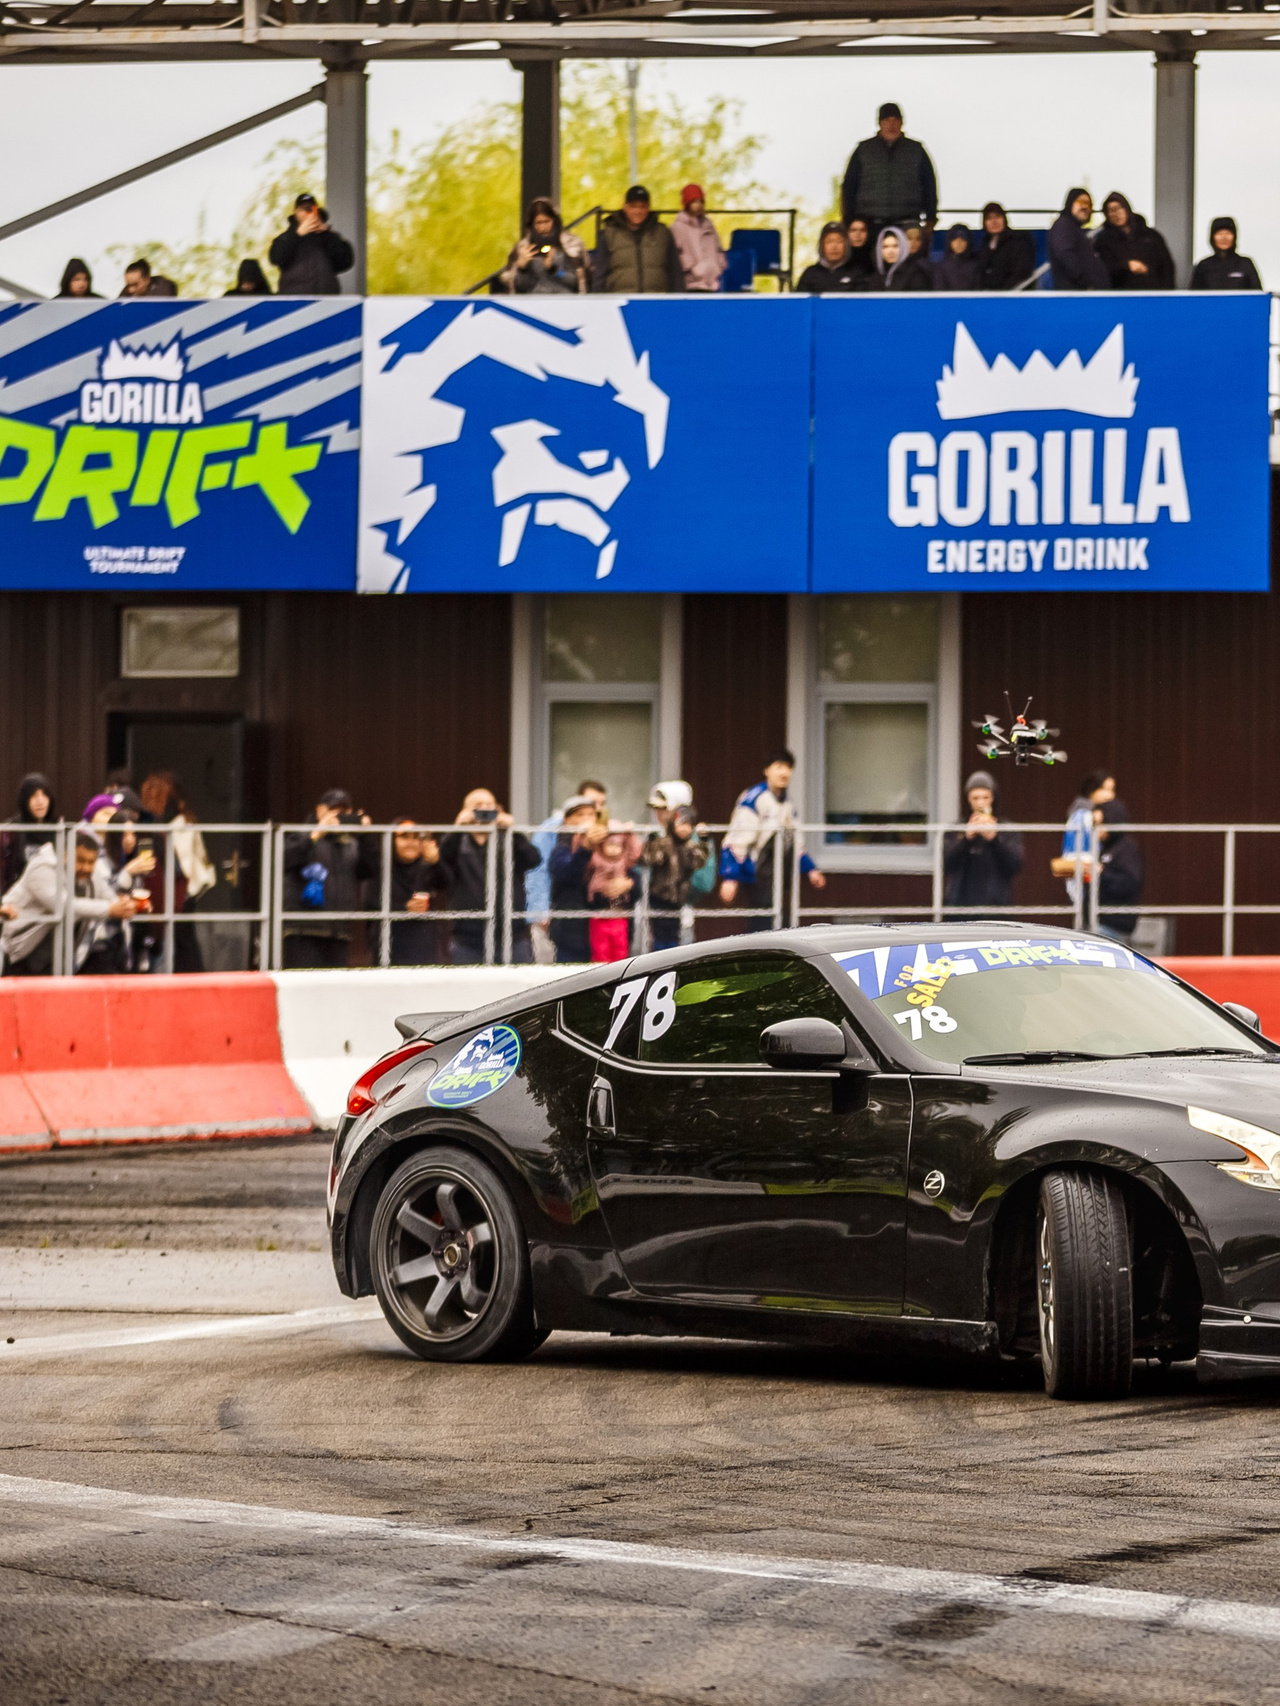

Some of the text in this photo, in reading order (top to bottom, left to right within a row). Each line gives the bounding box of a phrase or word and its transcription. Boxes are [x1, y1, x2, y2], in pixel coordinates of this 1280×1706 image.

[81, 382, 203, 424] GORILLA
[0, 416, 323, 535] DRIFT
[888, 427, 1191, 527] GORILLA
[83, 546, 145, 561] ULTIMATE
[89, 561, 179, 574] TOURNAMENT
[927, 537, 1150, 573] ENERGY DRINK
[977, 944, 1080, 967] DRIFT
[894, 965, 916, 988] FOR
[906, 962, 951, 1008] SALE
[602, 971, 677, 1051] 78
[892, 1005, 958, 1041] 78
